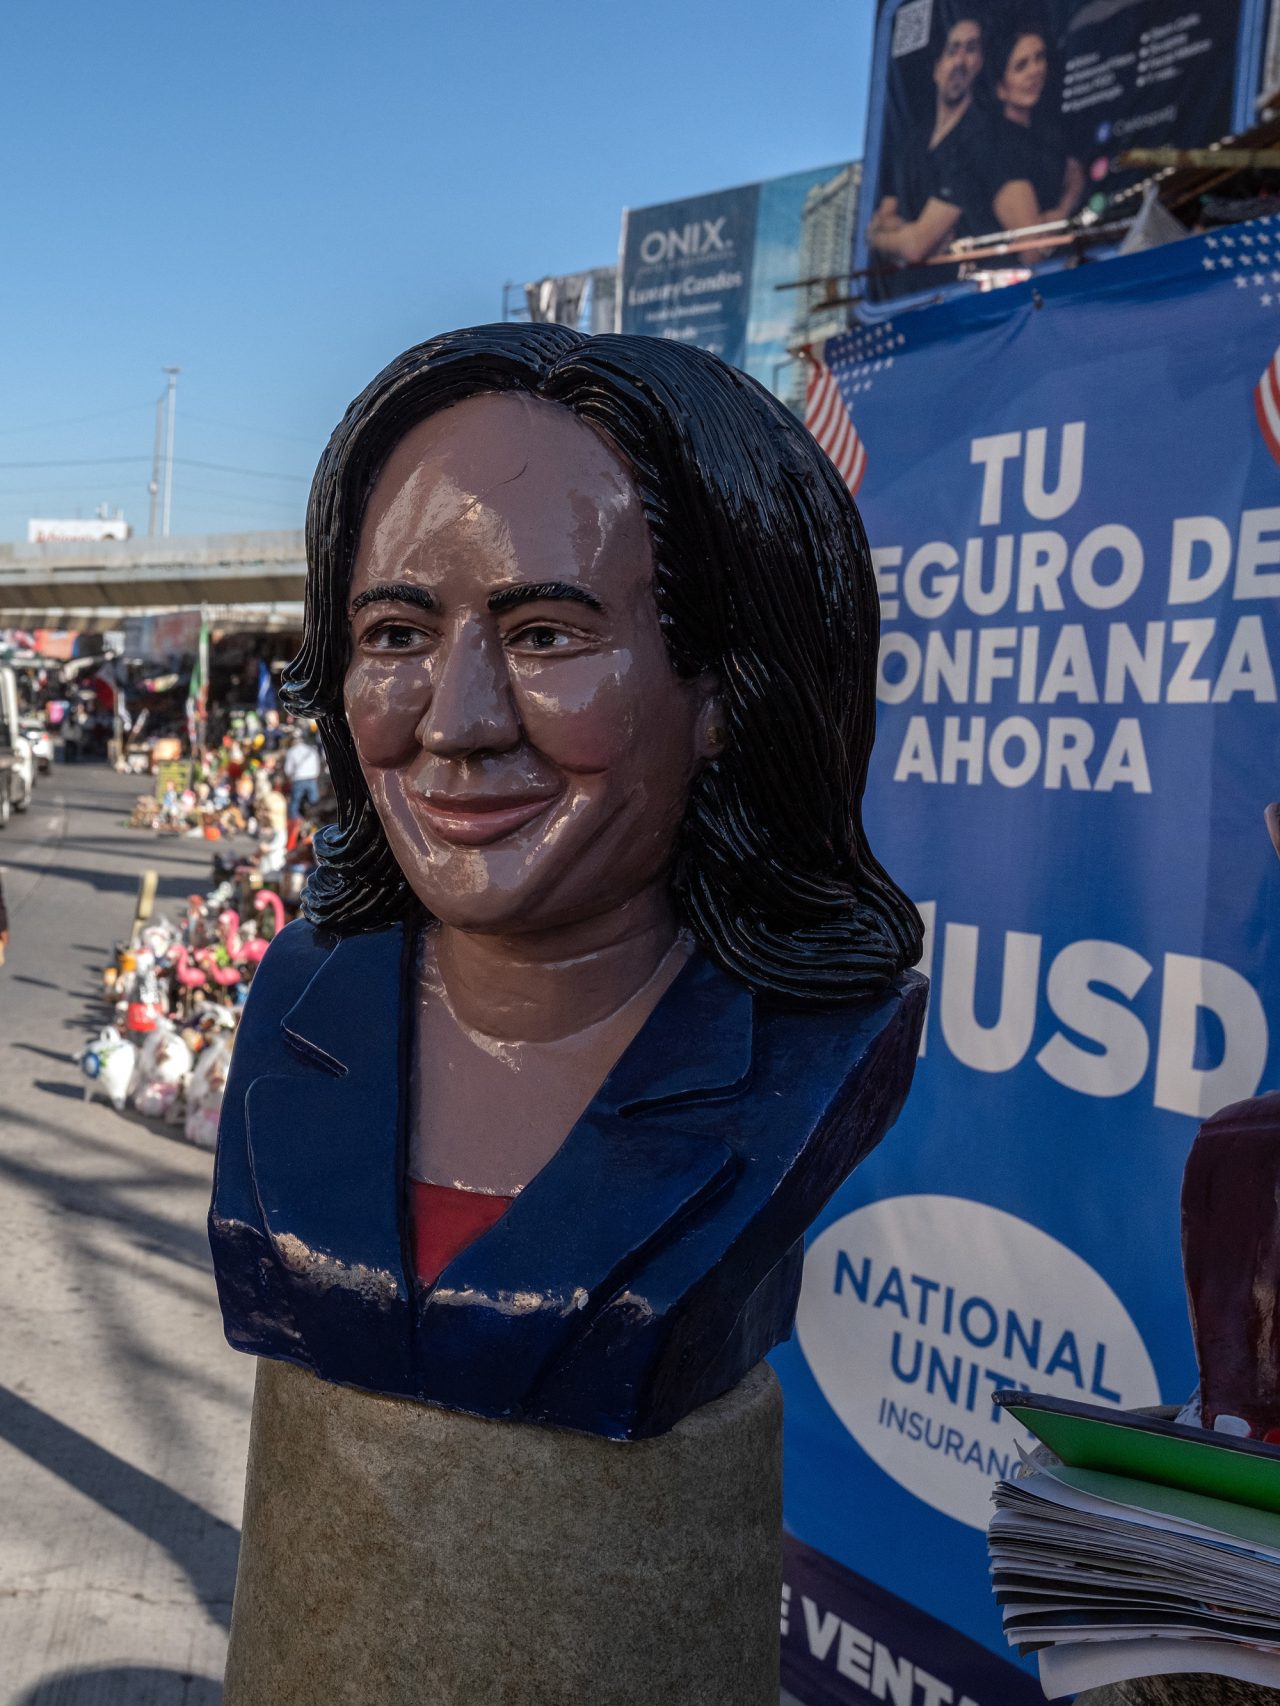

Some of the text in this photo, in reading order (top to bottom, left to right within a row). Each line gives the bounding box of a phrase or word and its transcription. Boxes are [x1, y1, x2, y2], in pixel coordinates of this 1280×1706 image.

[970, 421, 1087, 526] TU
[870, 506, 1280, 621] EGURO DE
[874, 614, 1279, 705] ONFIANZA
[892, 714, 1153, 795] AHORA
[832, 1249, 1122, 1404] NATIONAL
[890, 1331, 1034, 1426] UNIT
[801, 1594, 980, 1706] VENT
